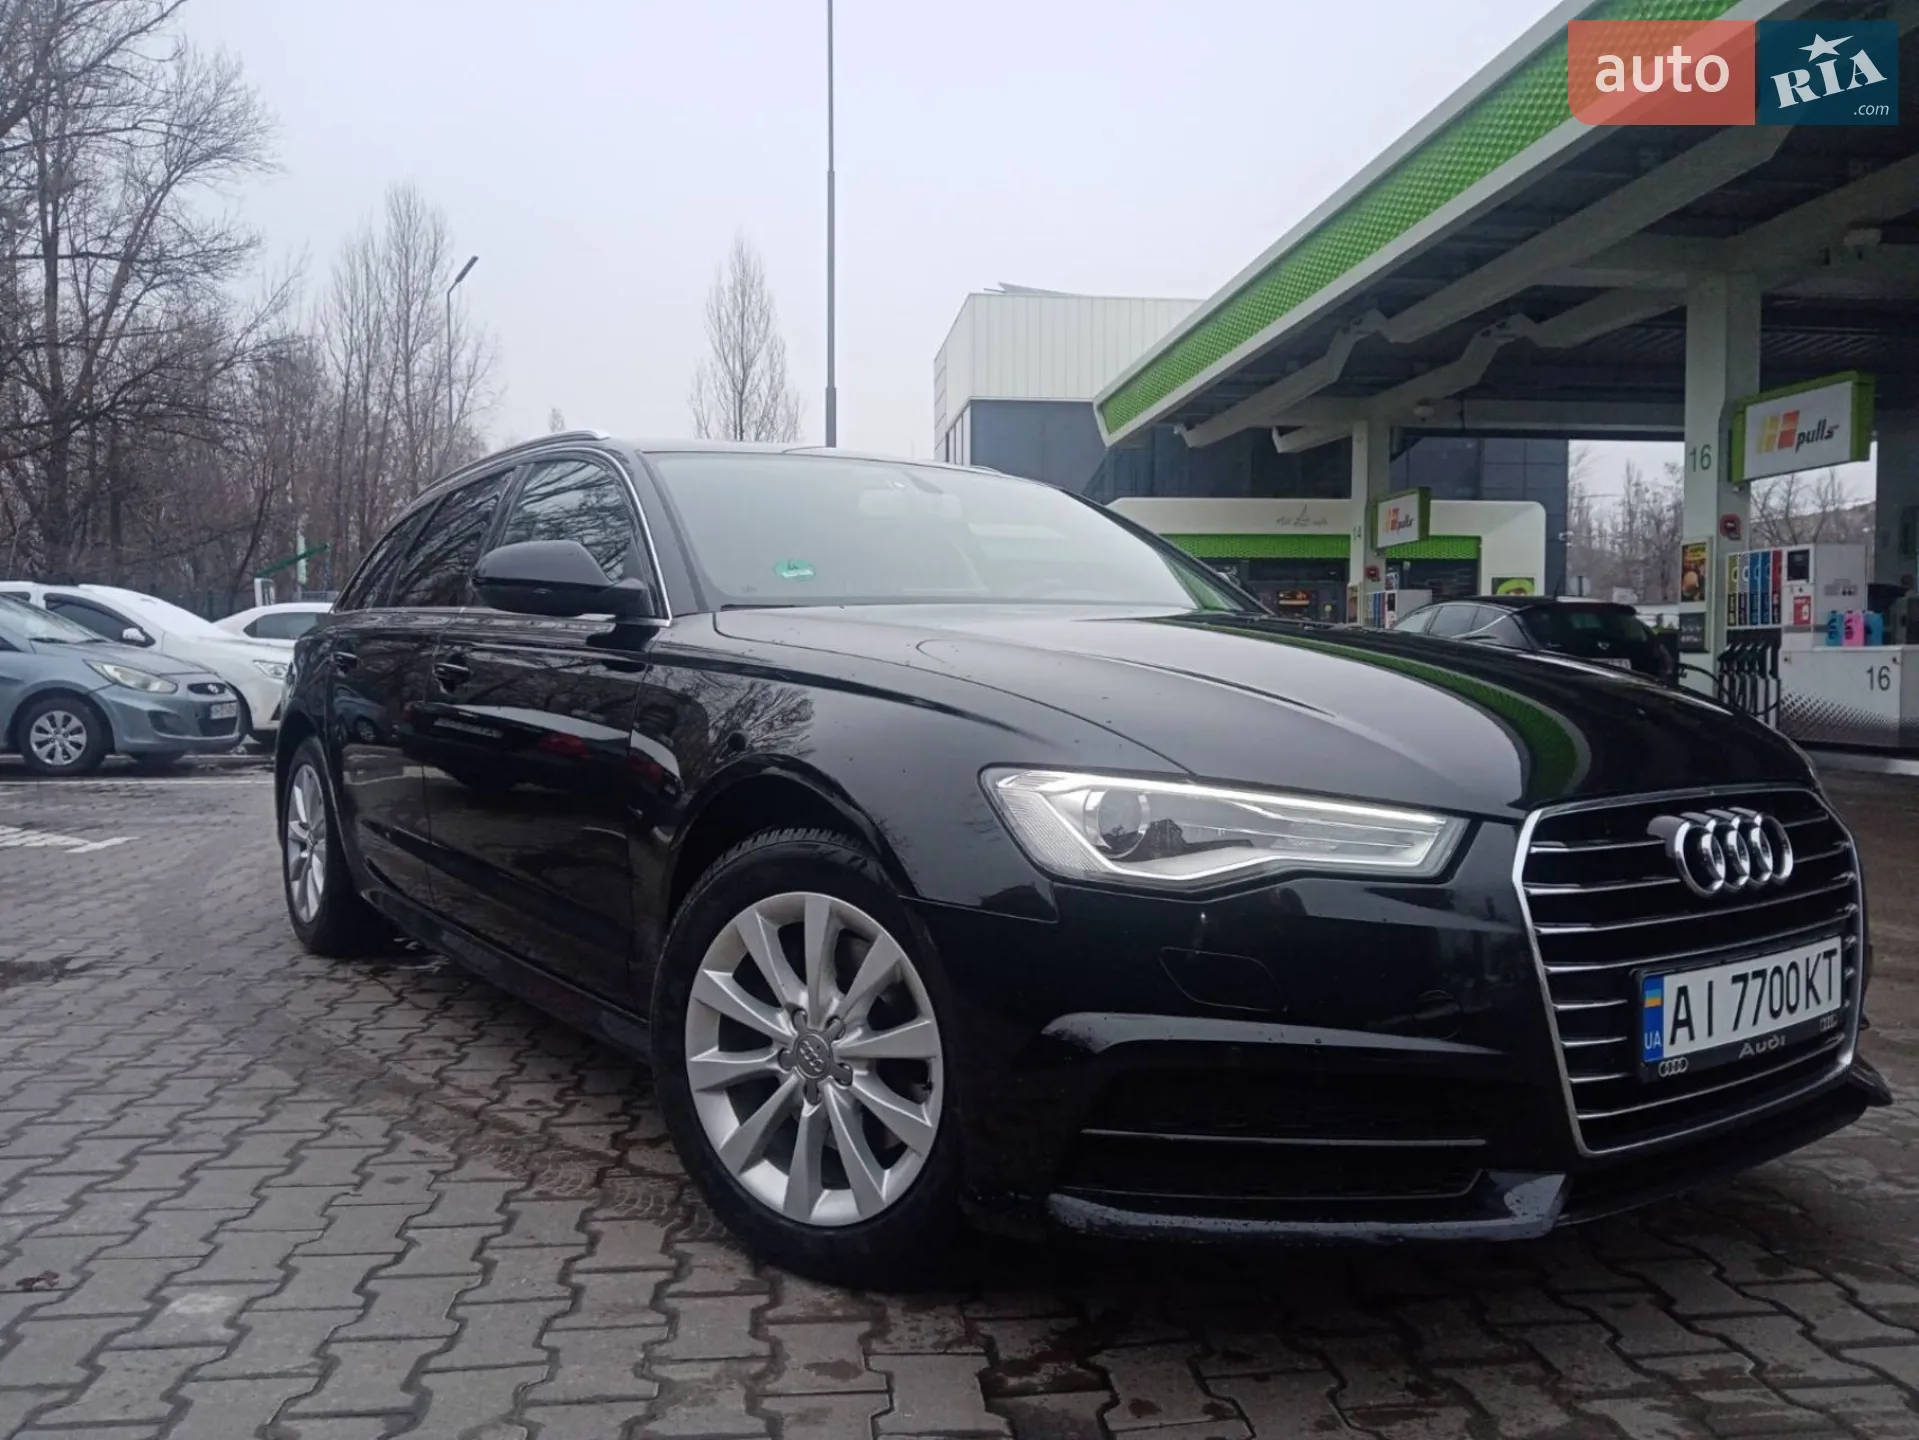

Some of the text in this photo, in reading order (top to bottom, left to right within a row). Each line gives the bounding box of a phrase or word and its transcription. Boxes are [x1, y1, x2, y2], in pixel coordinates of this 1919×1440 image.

[1795, 418, 1839, 453] pulls
[1689, 443, 1712, 473] 16
[1866, 665, 1892, 691] 16
[1644, 1030, 1662, 1050] UA
[1738, 1034, 1787, 1060] Audi
